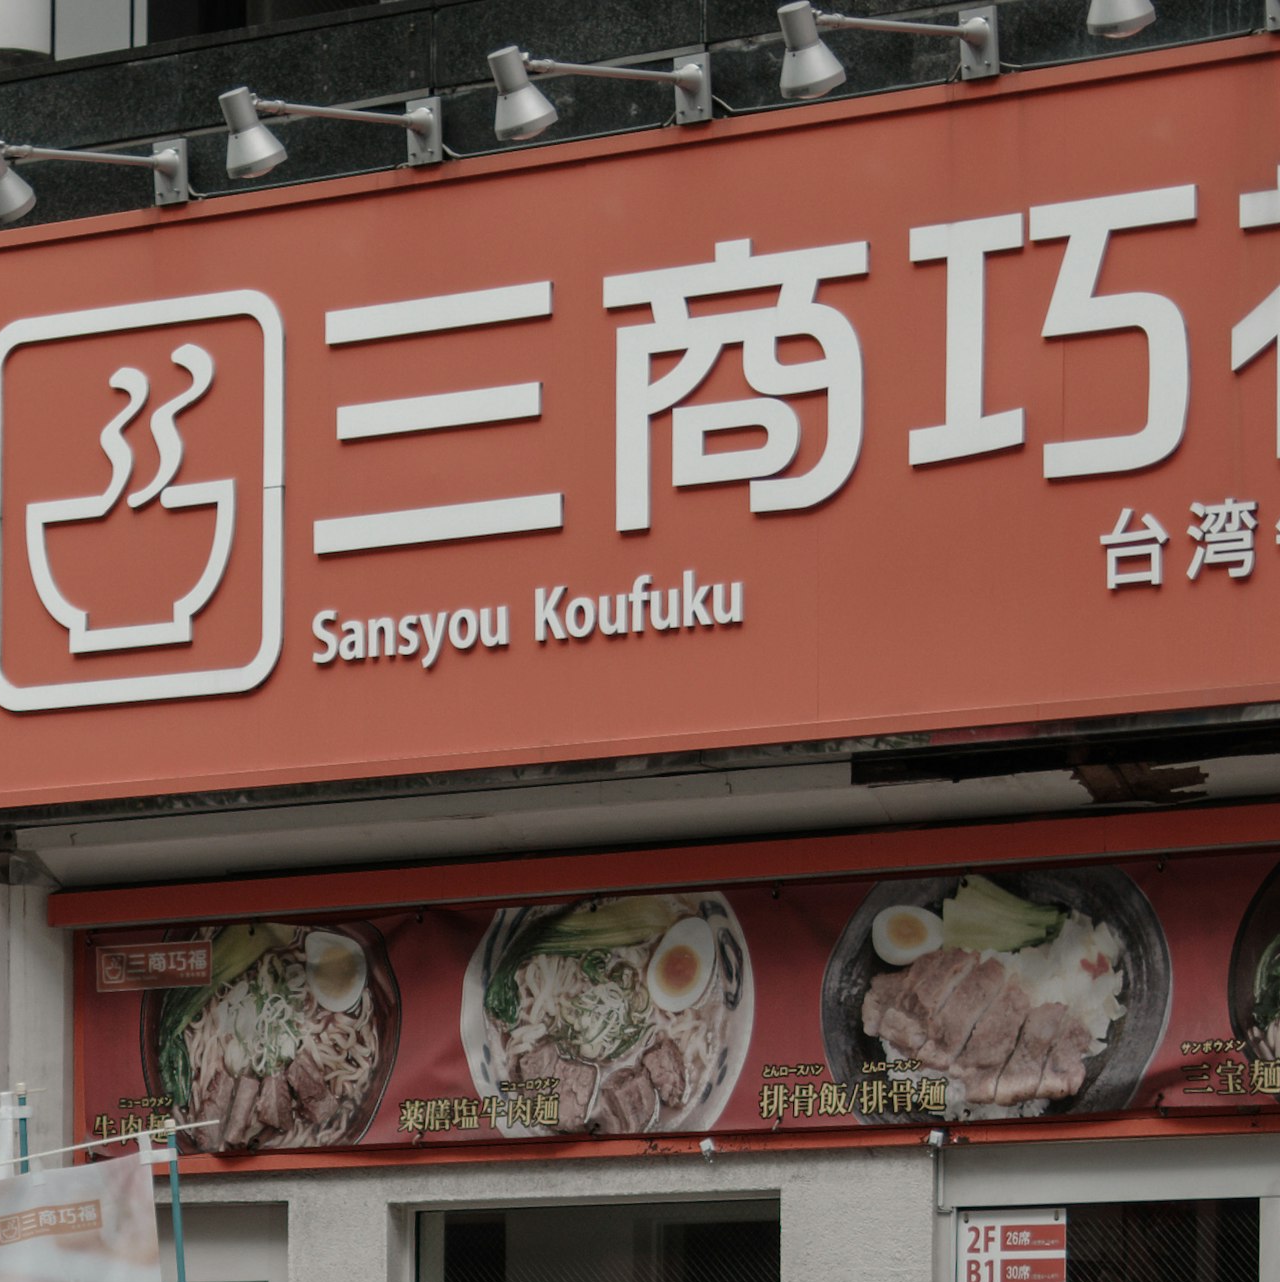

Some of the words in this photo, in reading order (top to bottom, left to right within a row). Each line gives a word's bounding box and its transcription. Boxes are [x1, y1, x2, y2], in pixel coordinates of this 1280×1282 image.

[312, 604, 509, 669] Sansyou
[534, 570, 744, 642] Koufuku
[128, 952, 208, 976] 三商巧福
[21, 1205, 97, 1233] 三商巧福
[967, 1225, 996, 1254] 2F
[1006, 1231, 1031, 1247] 26席
[1006, 1264, 1031, 1281] 30席
